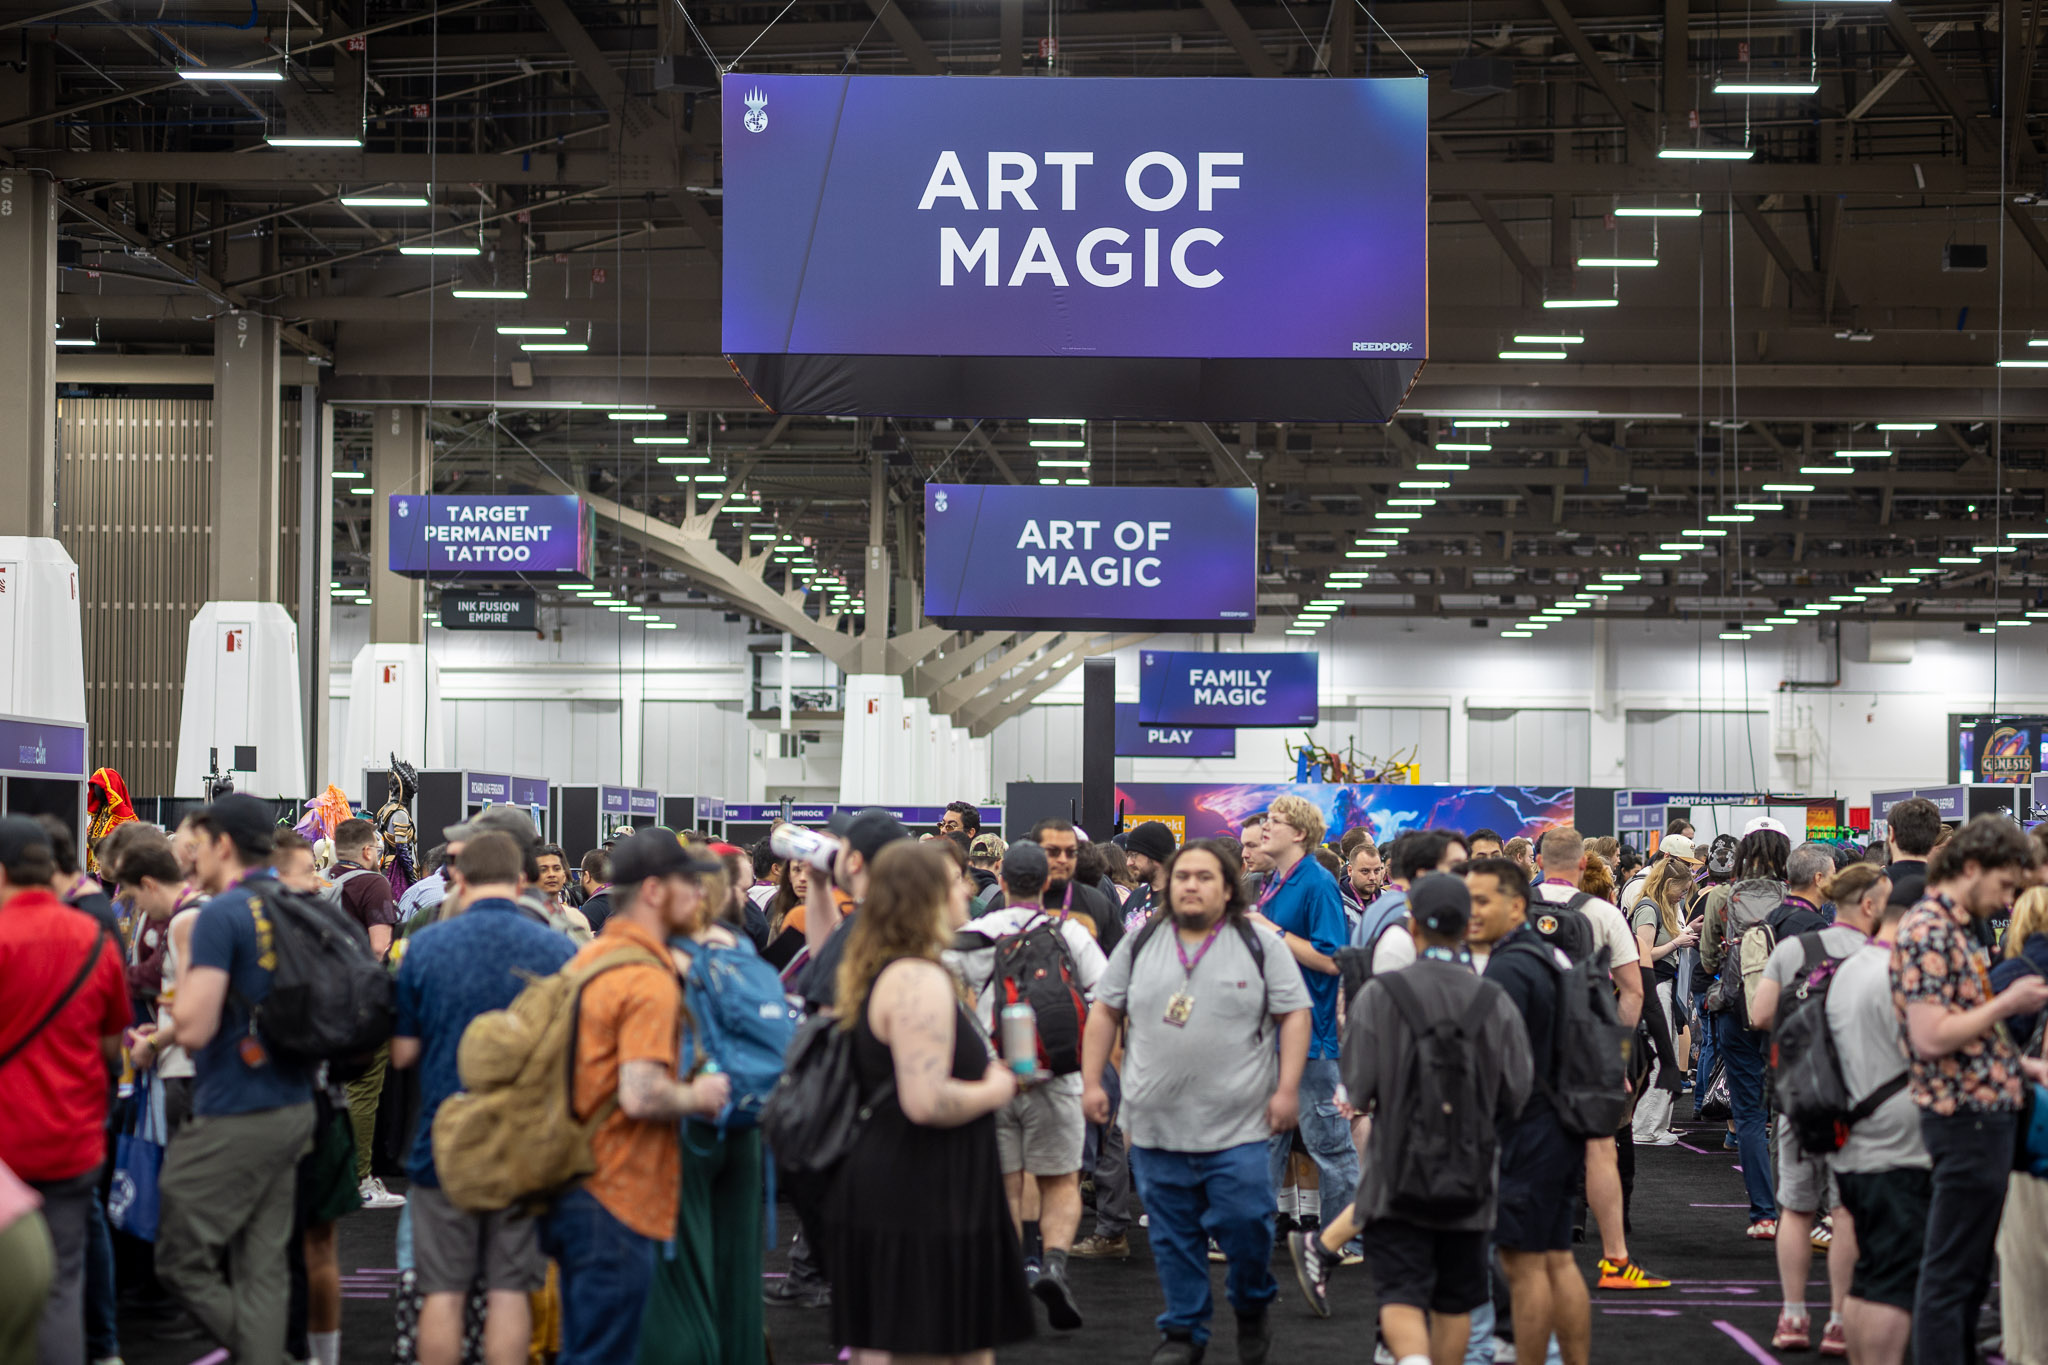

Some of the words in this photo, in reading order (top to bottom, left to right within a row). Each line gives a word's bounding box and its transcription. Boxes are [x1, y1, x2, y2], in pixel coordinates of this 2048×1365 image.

[918, 151, 1093, 210] ART
[1126, 152, 1243, 211] OF
[941, 228, 1224, 288] MAGIC
[237, 334, 247, 349] 7
[1352, 342, 1407, 352] REEDPOP
[447, 506, 529, 522] TARGET
[425, 526, 552, 542] PERMANENT
[1017, 520, 1100, 550] ART
[1114, 522, 1171, 551] OF
[445, 546, 530, 562] TATTOO
[1026, 556, 1161, 587] MAGIC
[458, 602, 476, 611] INK
[479, 602, 519, 611] FUSION
[469, 613, 508, 622] EMPIRE
[1190, 670, 1272, 687] FAMILY
[1194, 688, 1267, 706] MAGIC
[1148, 730, 1193, 744] PLAY
